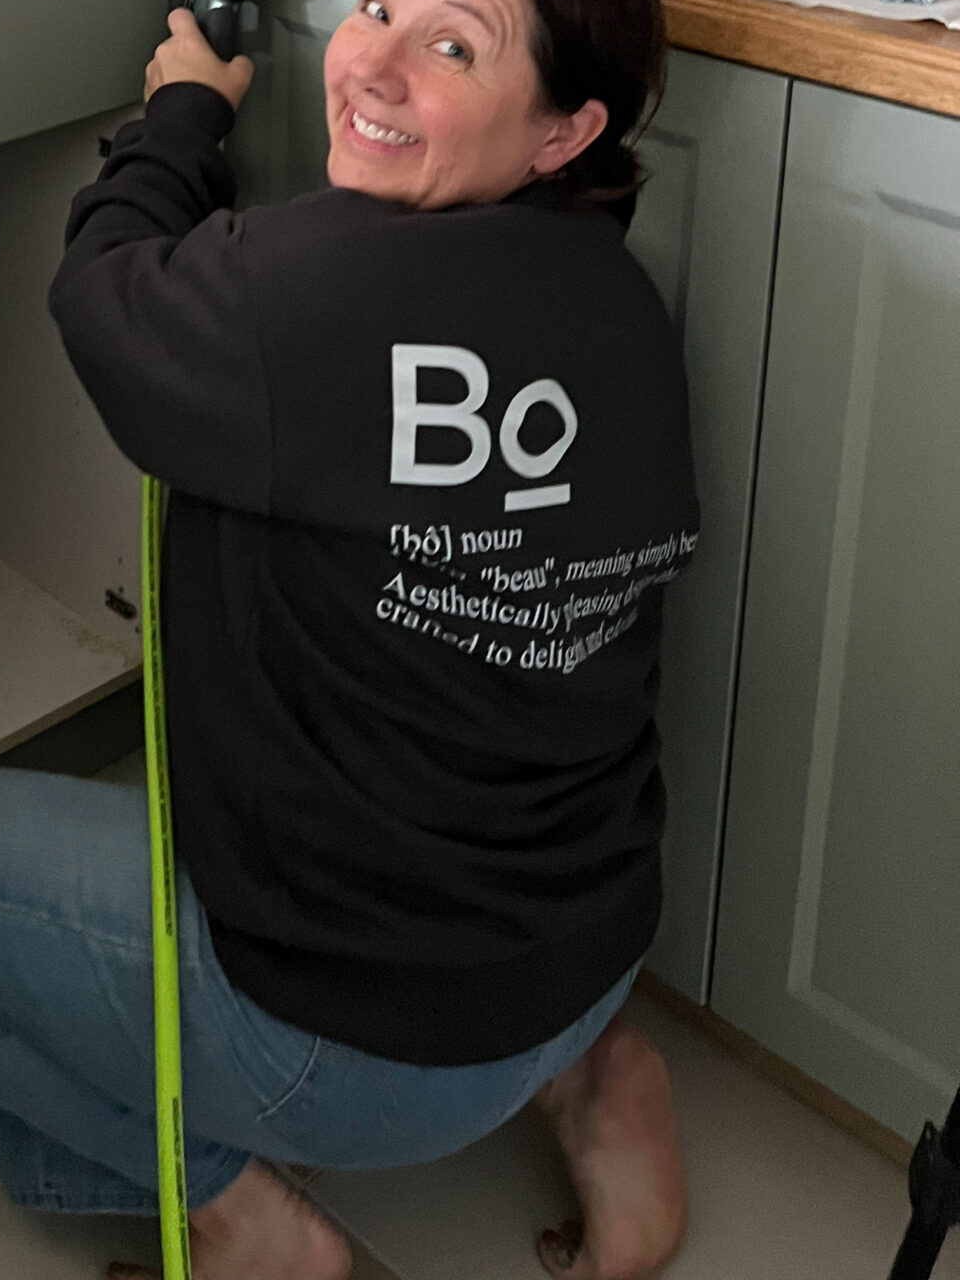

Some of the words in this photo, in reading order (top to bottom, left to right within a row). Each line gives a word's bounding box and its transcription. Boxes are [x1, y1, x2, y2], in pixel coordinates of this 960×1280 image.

[460, 528, 523, 555] noun
[564, 547, 635, 582] meaning
[636, 529, 678, 568] simply
[382, 571, 561, 635] Aesthetically
[485, 640, 513, 666] to
